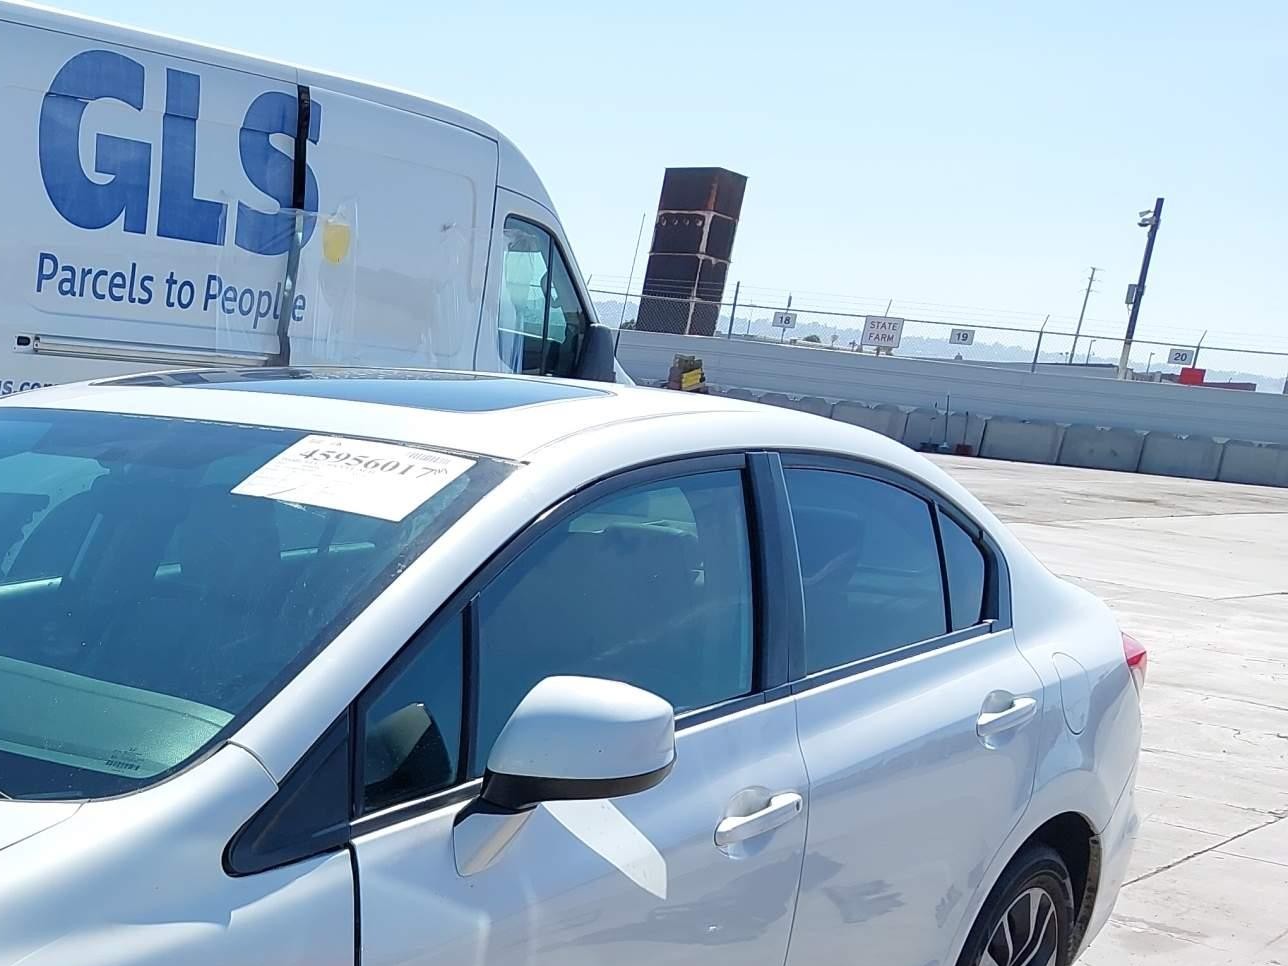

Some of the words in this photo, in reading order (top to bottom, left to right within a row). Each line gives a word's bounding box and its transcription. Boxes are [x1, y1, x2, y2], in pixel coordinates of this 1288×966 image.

[36, 252, 153, 305] Parcels
[166, 272, 195, 309] to
[203, 274, 306, 329] People
[779, 316, 791, 325] 18
[870, 321, 898, 331] STATE
[868, 333, 895, 342] FARM
[956, 332, 969, 342] 19
[1174, 352, 1188, 362] 20
